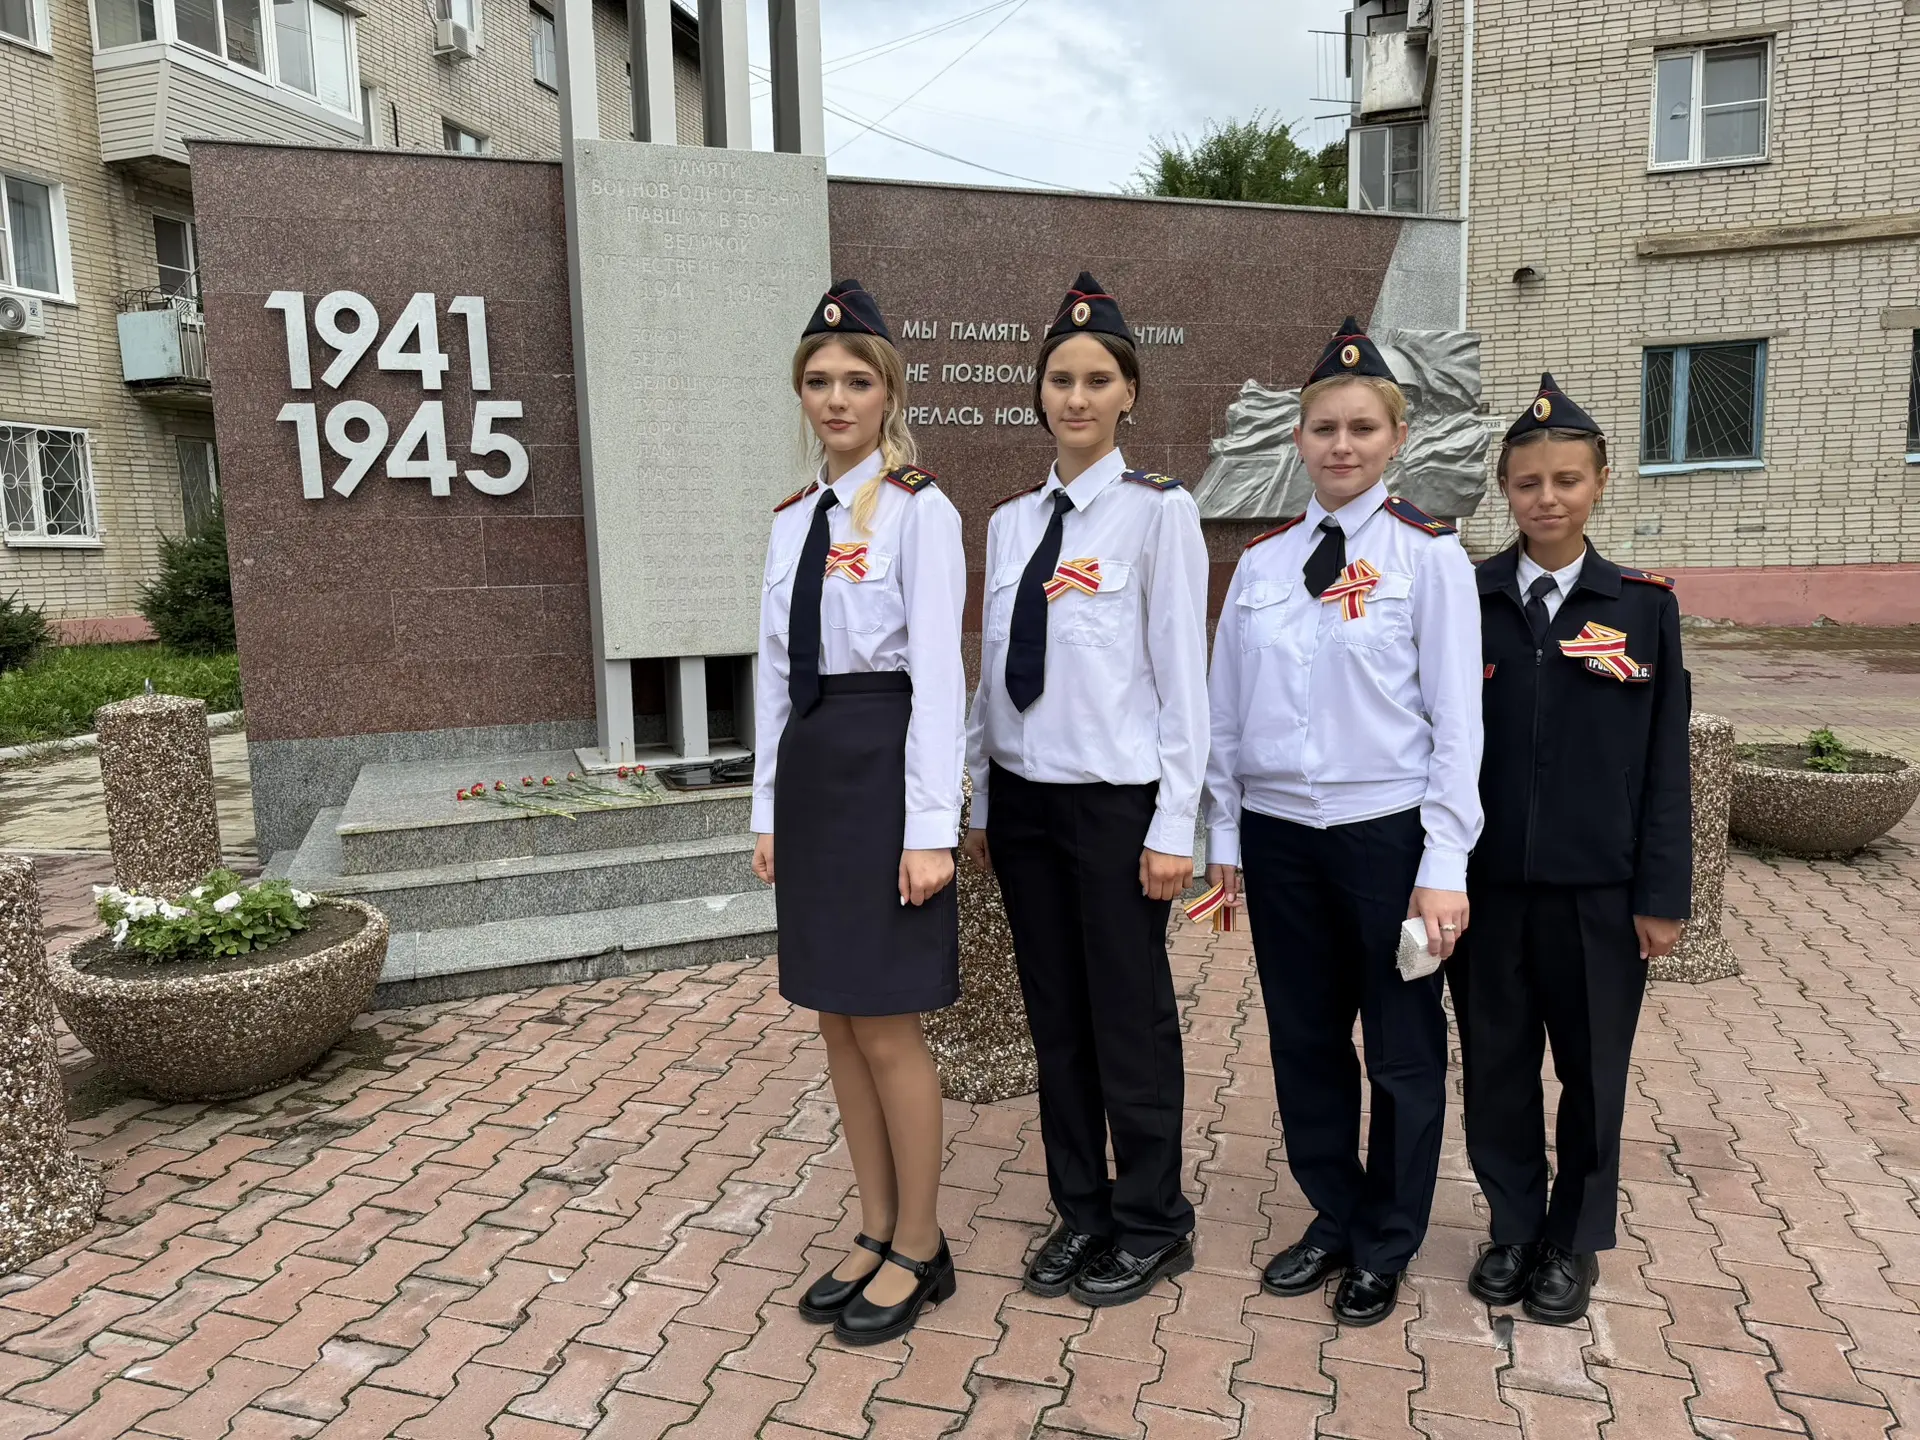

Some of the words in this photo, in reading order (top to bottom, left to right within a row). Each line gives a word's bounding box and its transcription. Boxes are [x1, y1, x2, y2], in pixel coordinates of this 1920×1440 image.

[666, 157, 741, 179] ПАМЯТИ
[664, 231, 751, 252] ВЕЛИКОЙ
[264, 290, 491, 390] 1941
[902, 320, 938, 339] МЫ
[950, 321, 1031, 342] ПАМЯТЬ
[1134, 326, 1184, 345] ЧТИМ
[906, 363, 930, 382] НЕ
[941, 363, 1037, 384] ПОЗВОЛИ
[904, 406, 984, 425] РЕЛАСЬ
[276, 400, 530, 499] 1945
